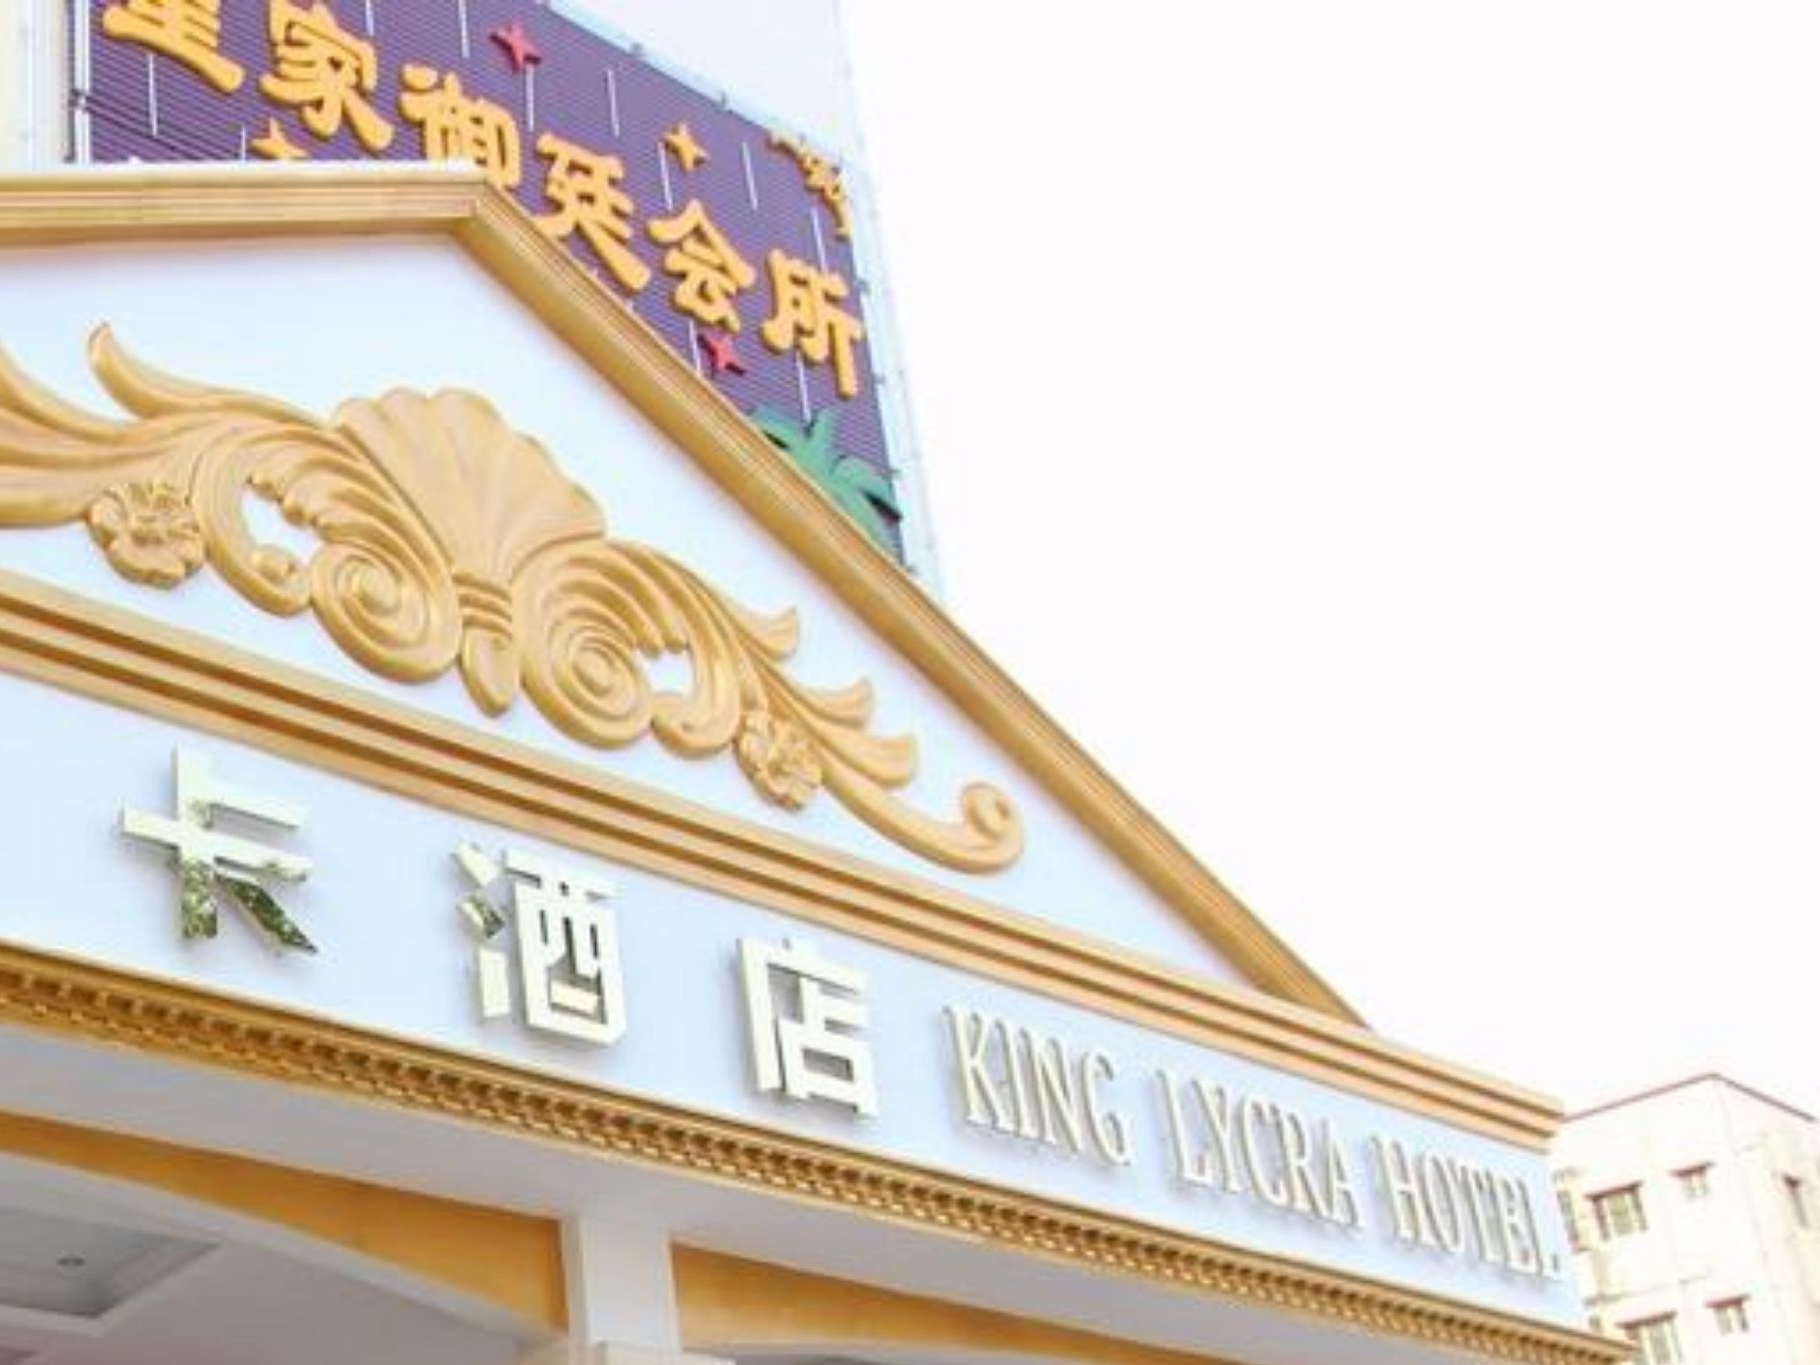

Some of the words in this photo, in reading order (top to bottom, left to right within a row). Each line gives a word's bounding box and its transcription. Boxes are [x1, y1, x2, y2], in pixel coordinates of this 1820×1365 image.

[943, 1005, 1132, 1168] KING
[1155, 1068, 1366, 1234] LYCRA
[1369, 1134, 1561, 1280] HOTEL
